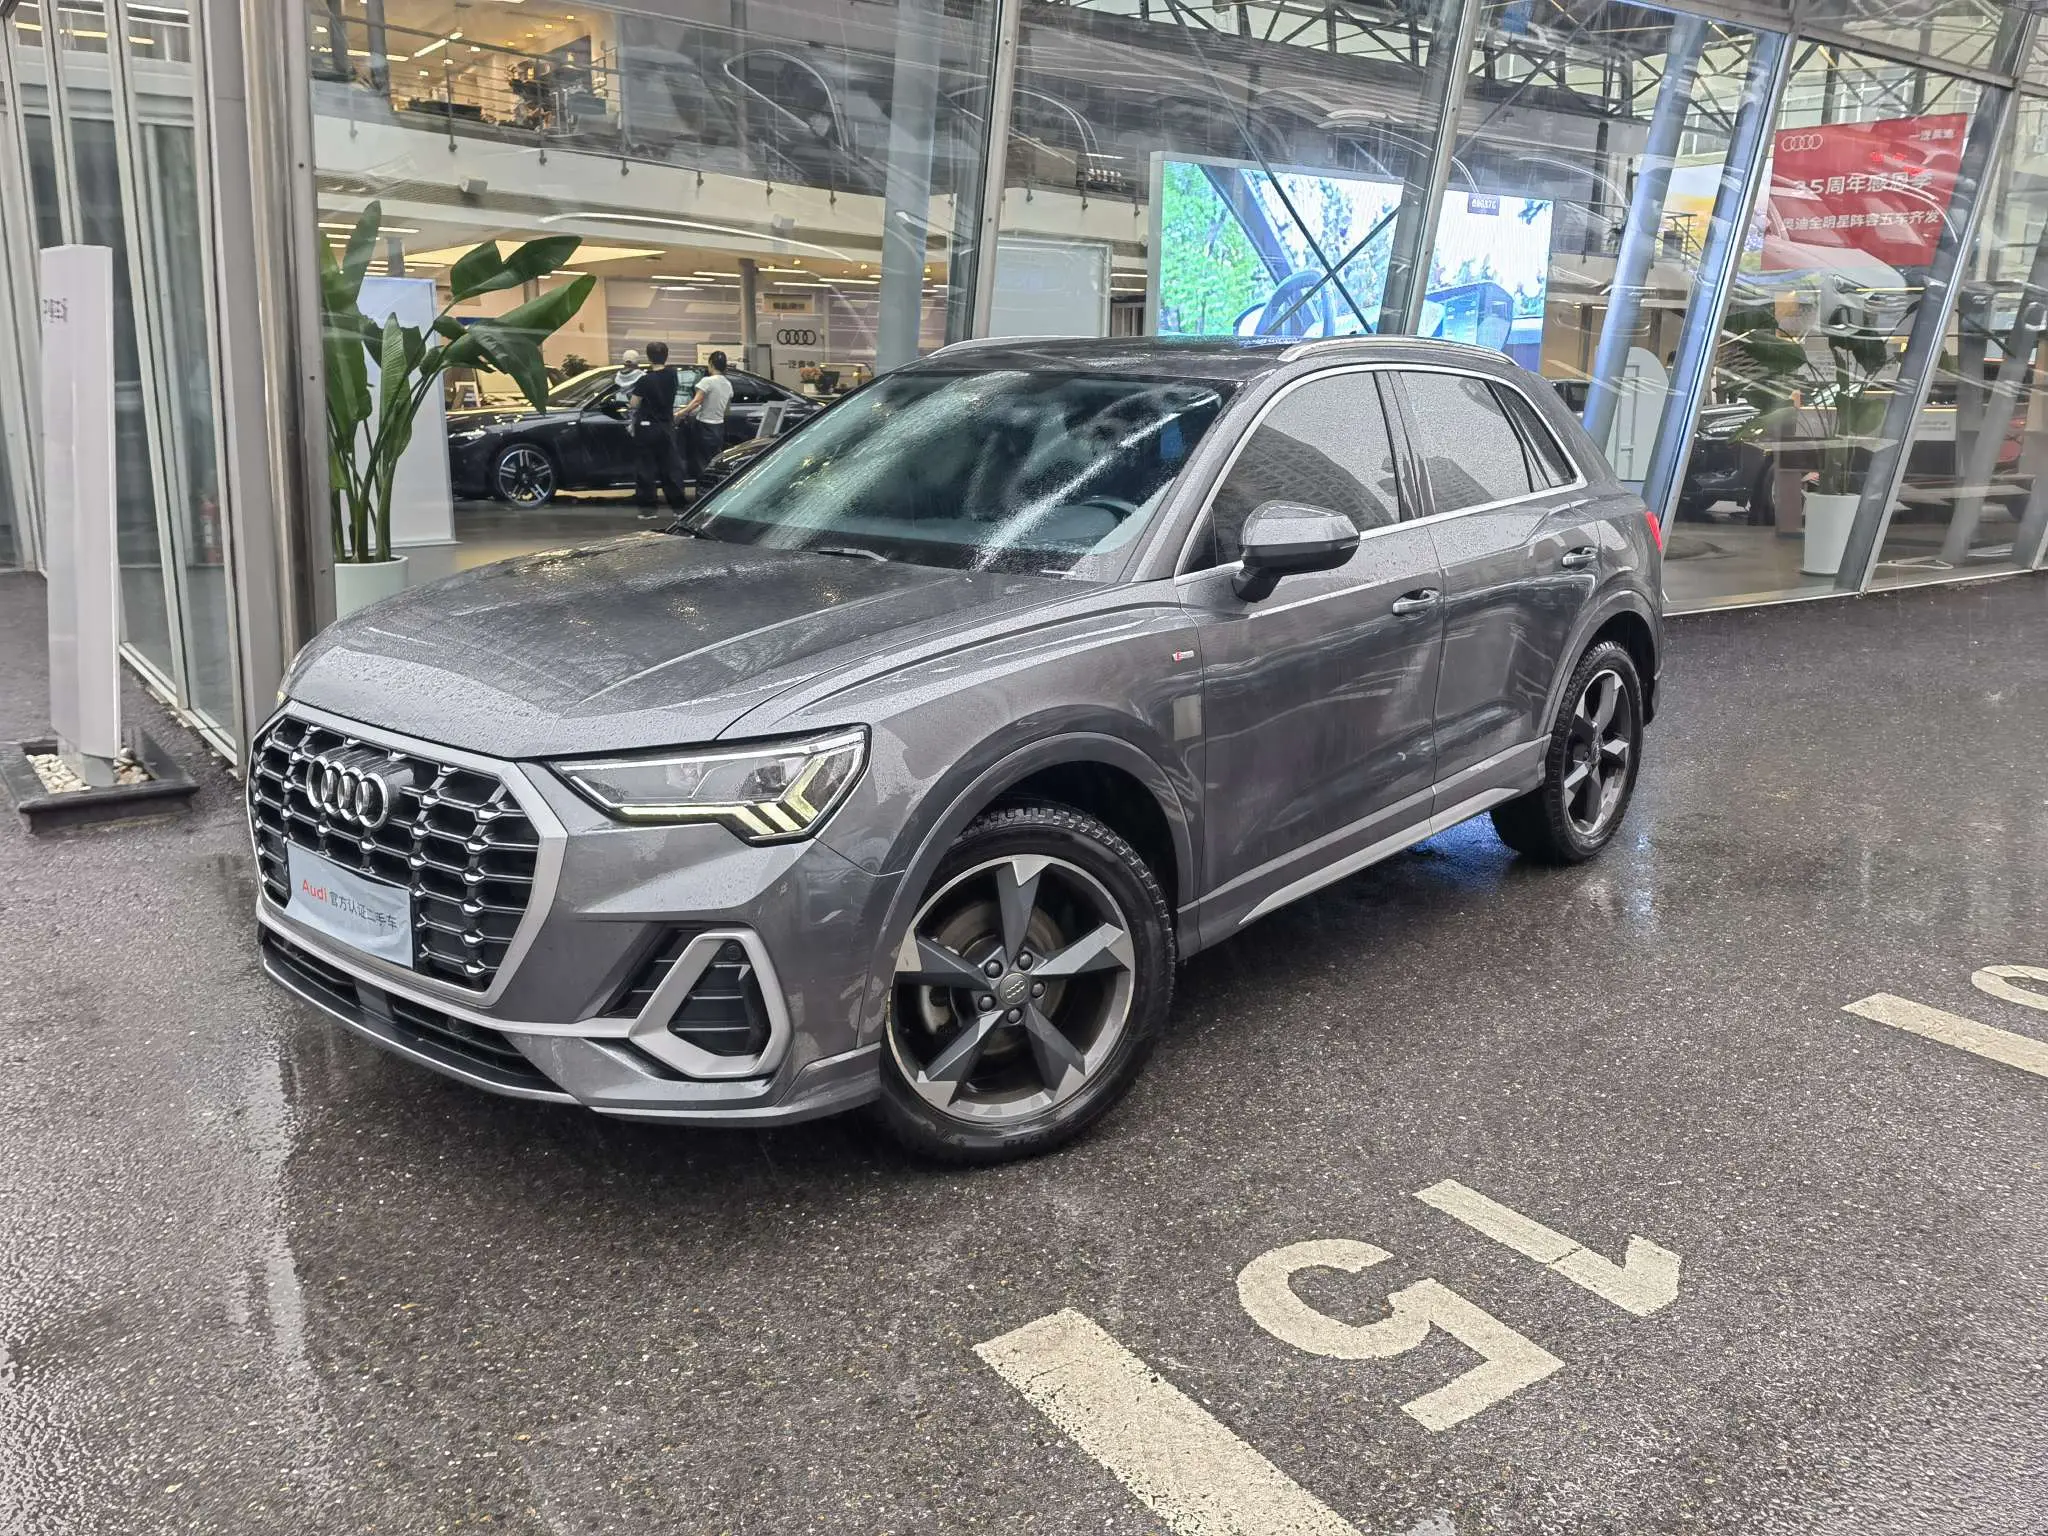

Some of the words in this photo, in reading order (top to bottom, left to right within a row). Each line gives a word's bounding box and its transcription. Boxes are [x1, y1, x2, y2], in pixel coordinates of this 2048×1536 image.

[302, 879, 329, 903] Audi
[329, 891, 398, 930] 官方认证二手车
[1236, 1178, 1682, 1432] 15
